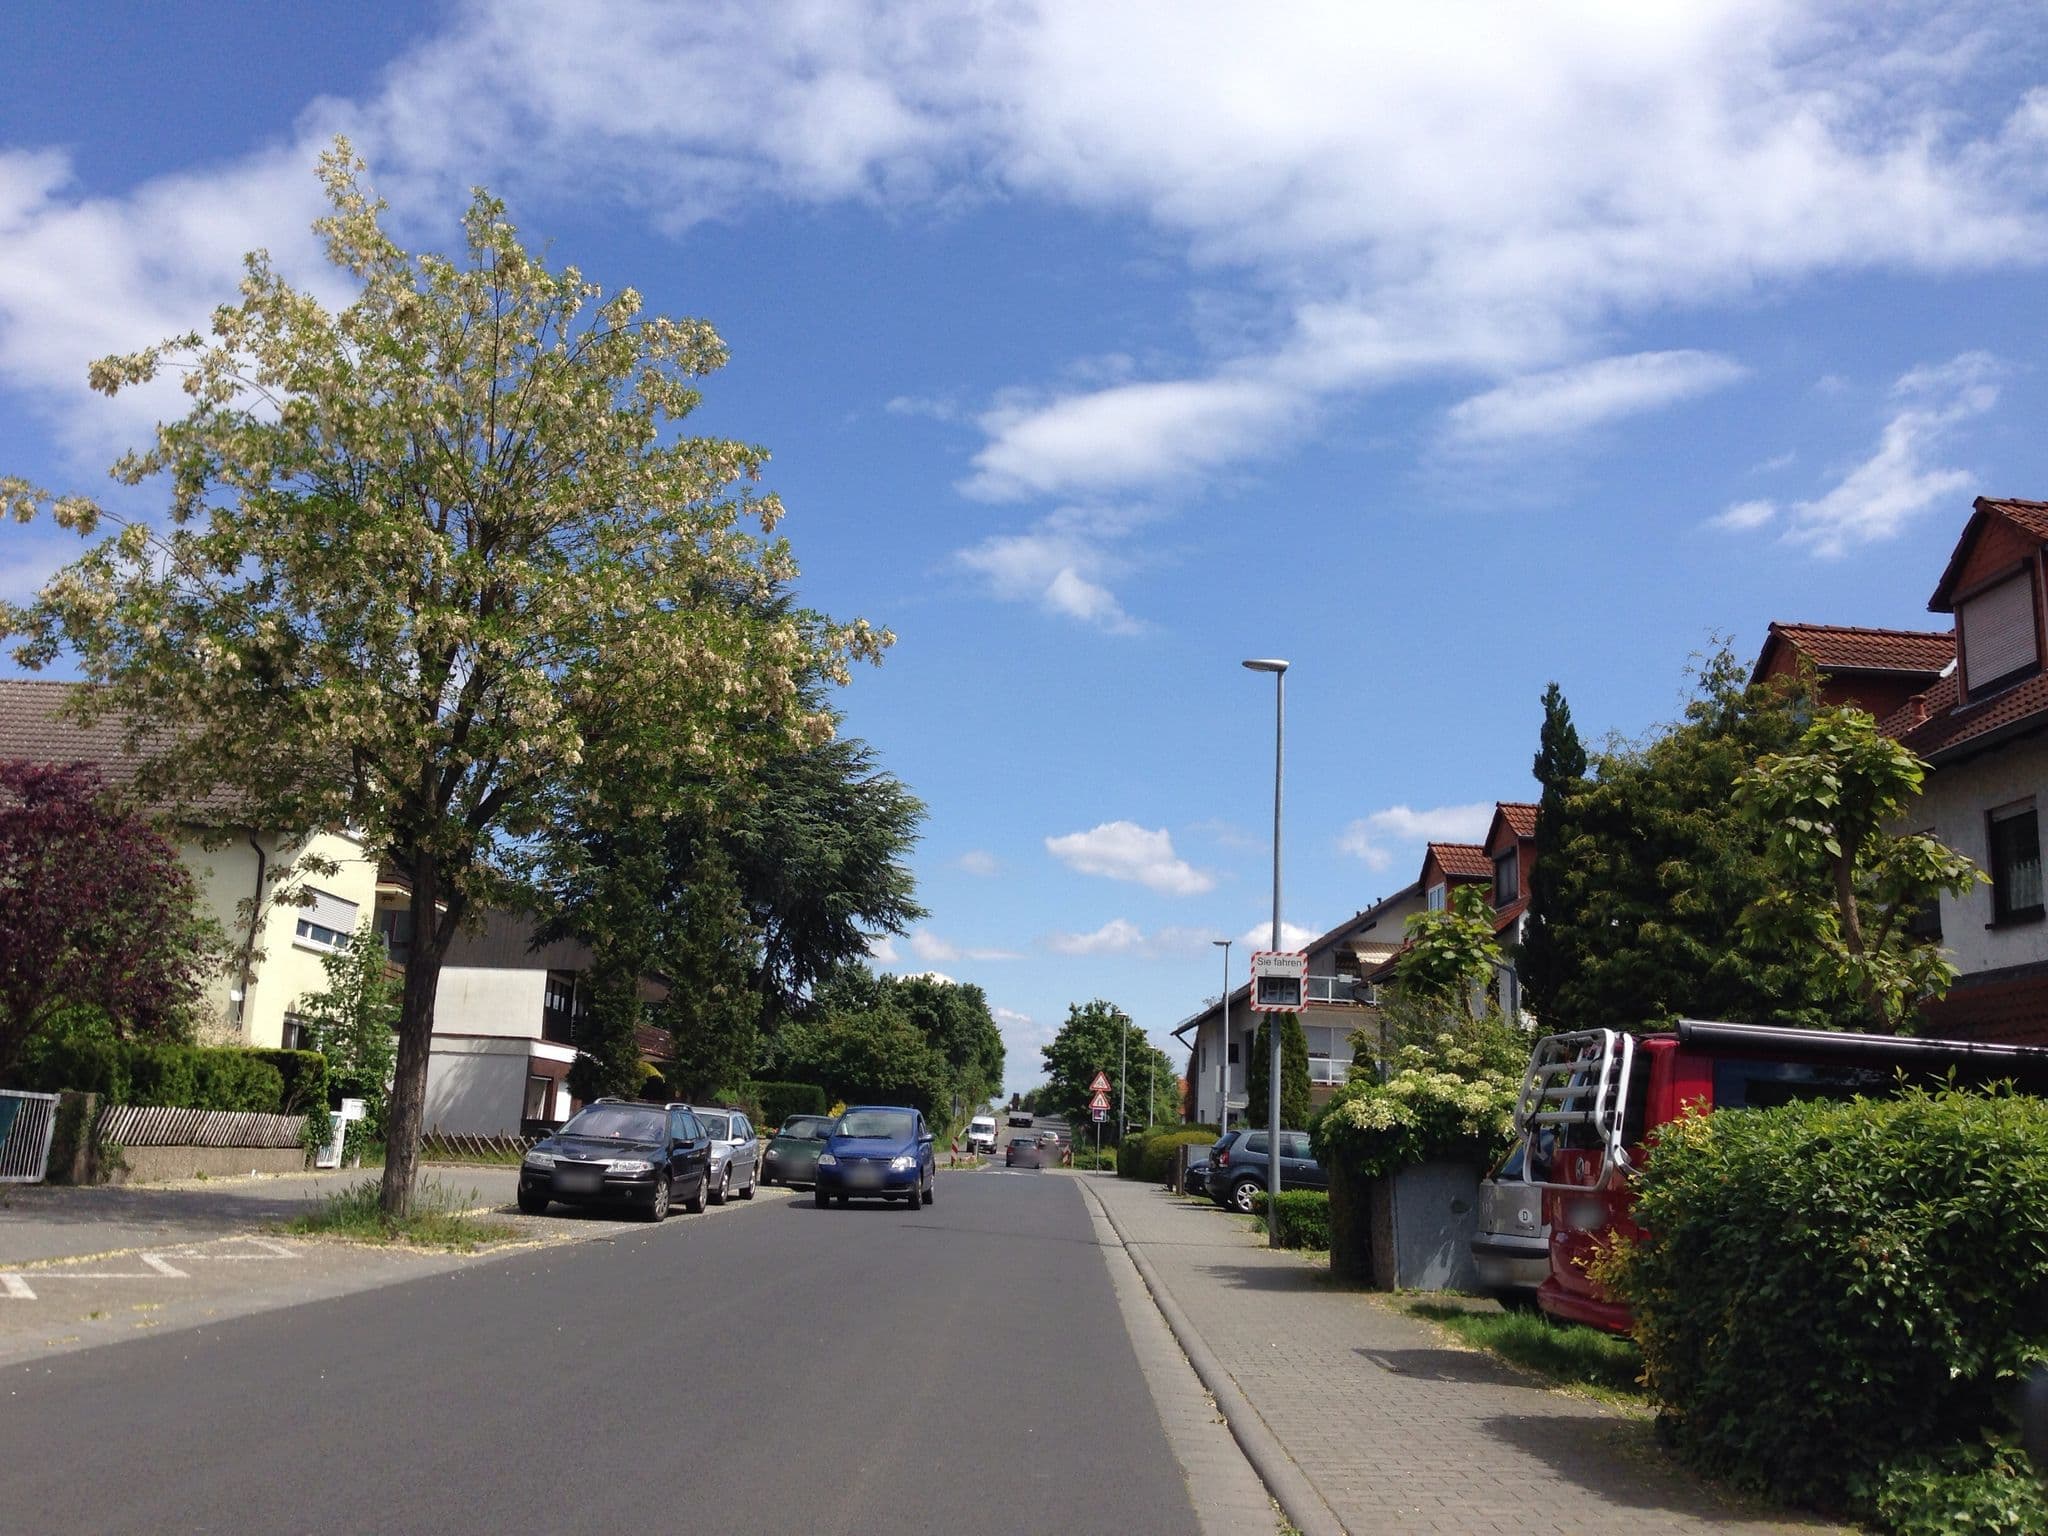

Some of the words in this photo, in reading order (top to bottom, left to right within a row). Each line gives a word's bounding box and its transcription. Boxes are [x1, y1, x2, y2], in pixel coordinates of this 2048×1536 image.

[1257, 957, 1271, 966] Sie
[1274, 958, 1302, 967] fahren
[1522, 1211, 1529, 1221] D
